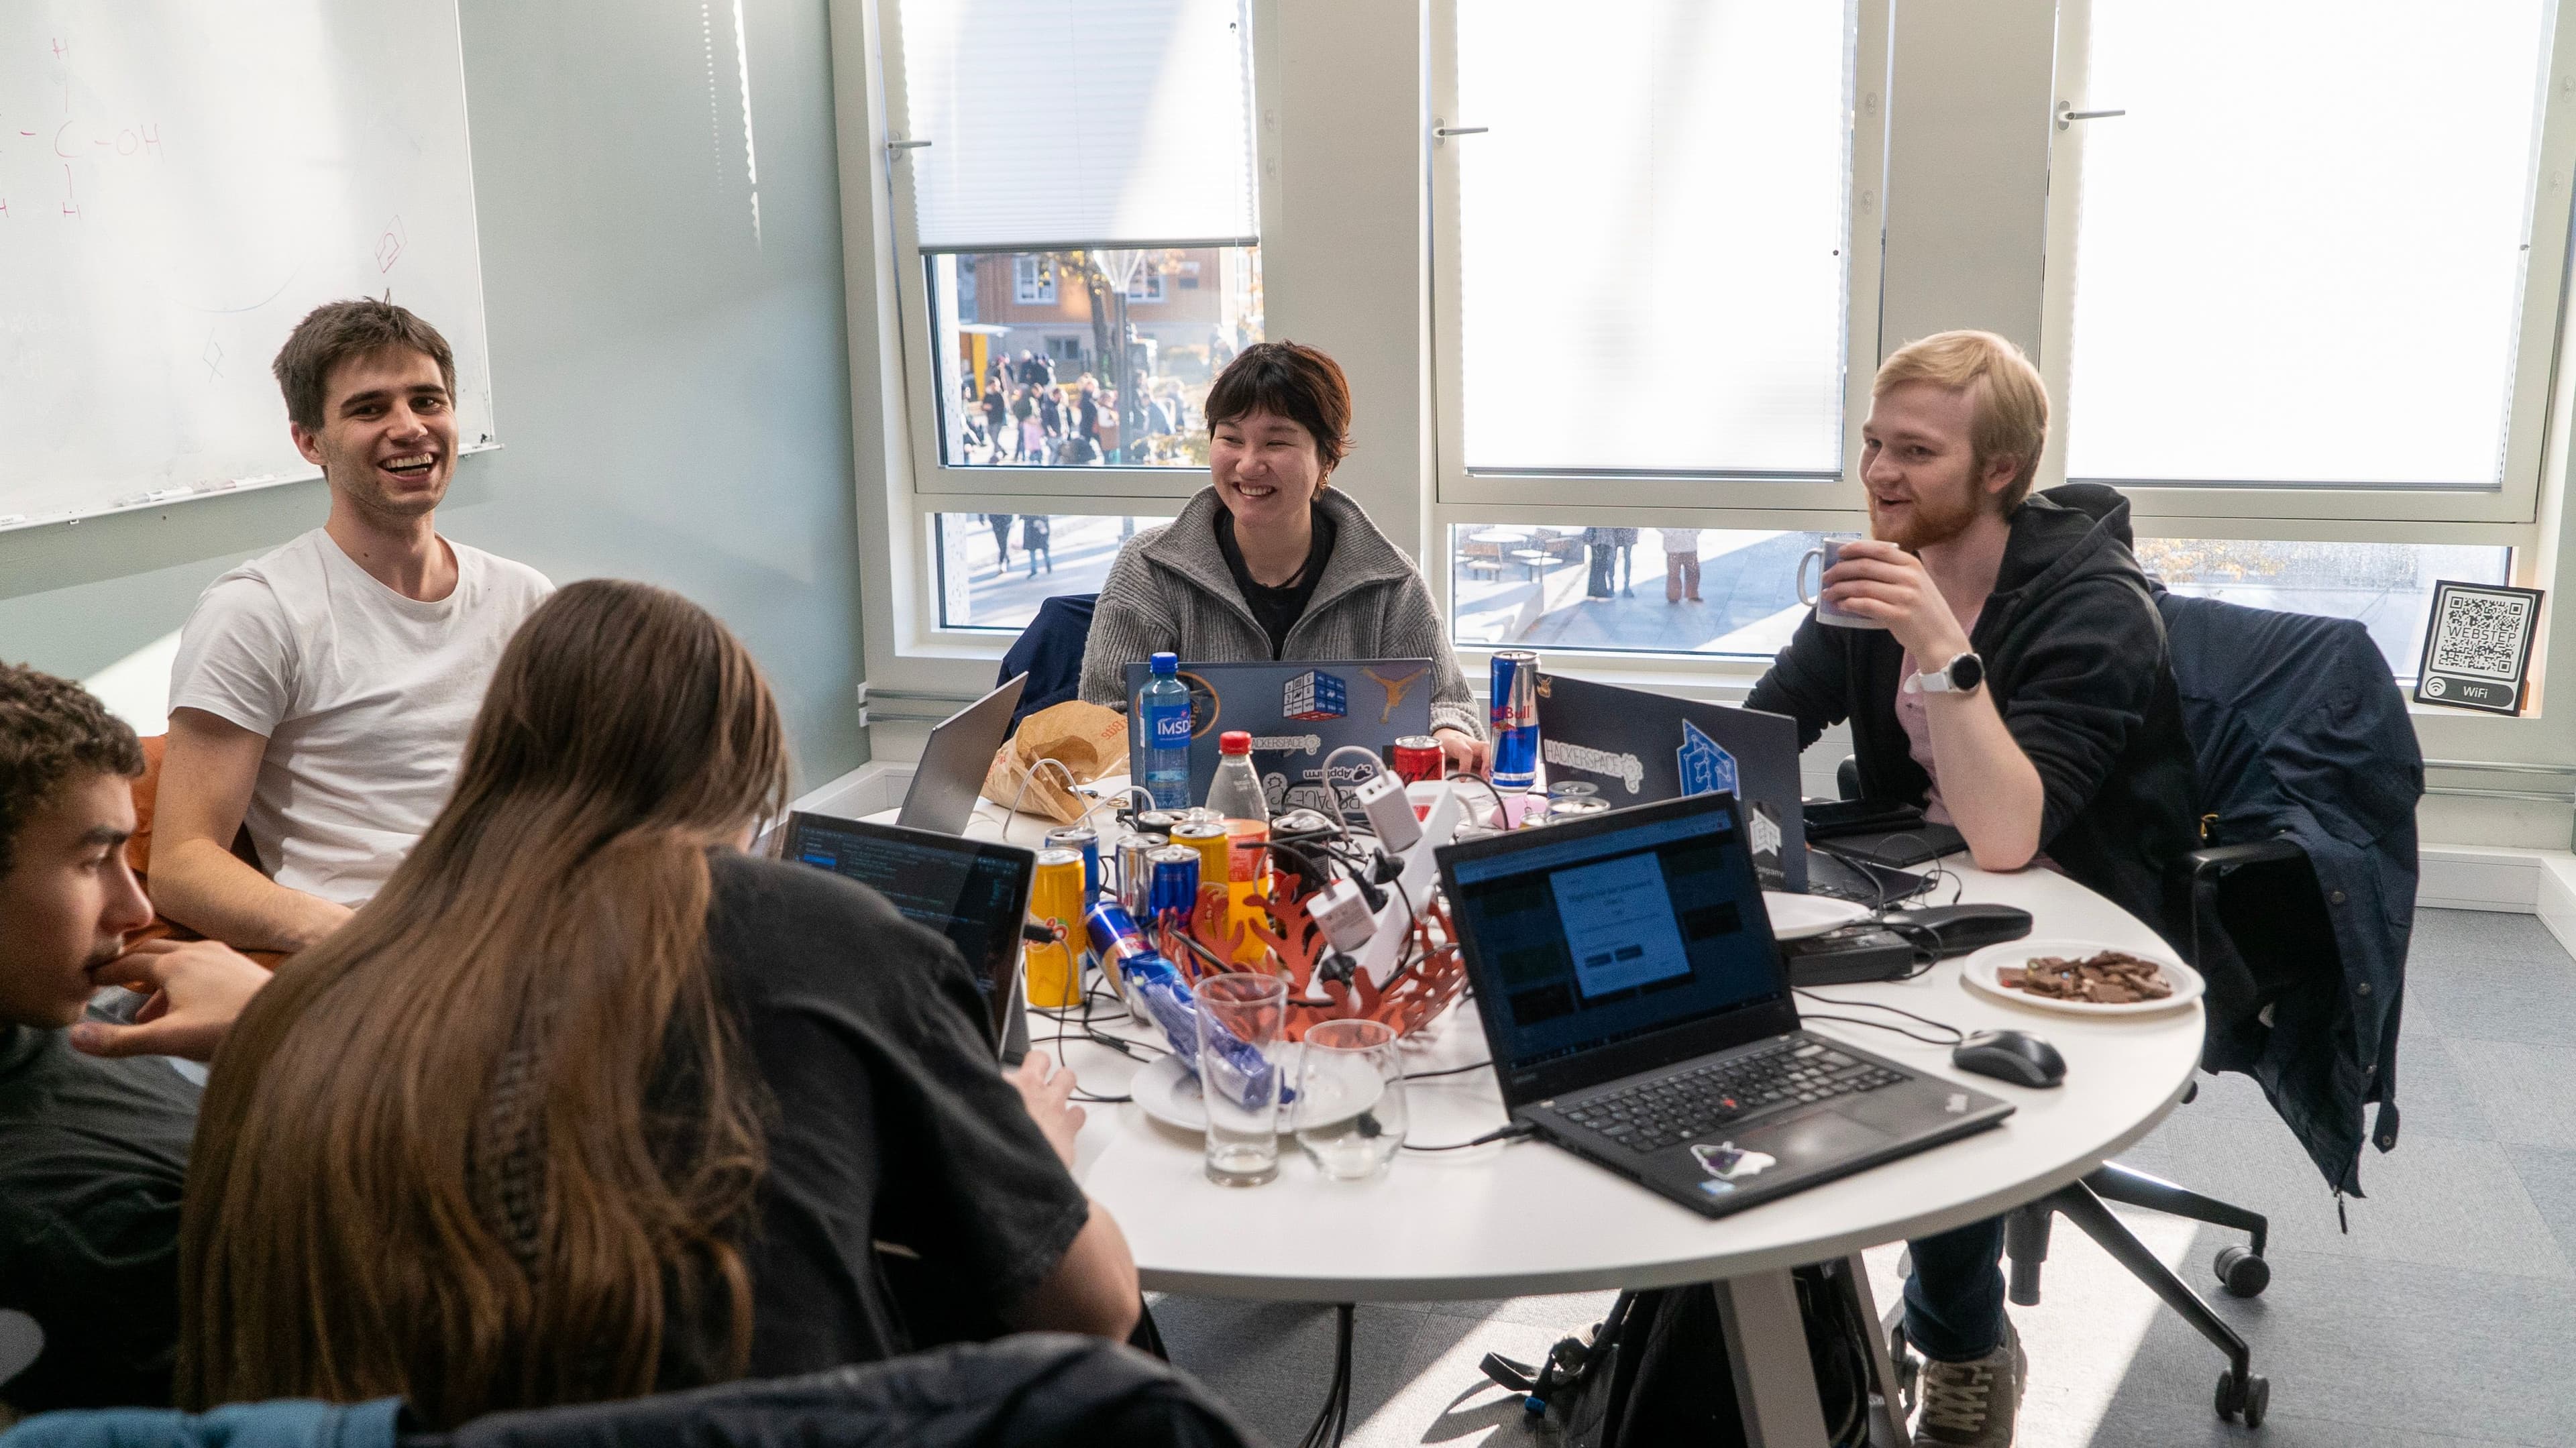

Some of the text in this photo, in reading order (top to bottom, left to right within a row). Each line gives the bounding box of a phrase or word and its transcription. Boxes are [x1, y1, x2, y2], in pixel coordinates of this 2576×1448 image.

[52, 38, 69, 60] H
[62, 201, 80, 220] H
[2447, 625, 2516, 643] WEBSTEP
[2463, 685, 2488, 699] WiFi
[1504, 705, 1529, 718] Bull
[1158, 720, 1191, 735] IMSD
[1252, 738, 1303, 748] ACKERSPACE
[1546, 742, 1619, 774] HACKERSPACE
